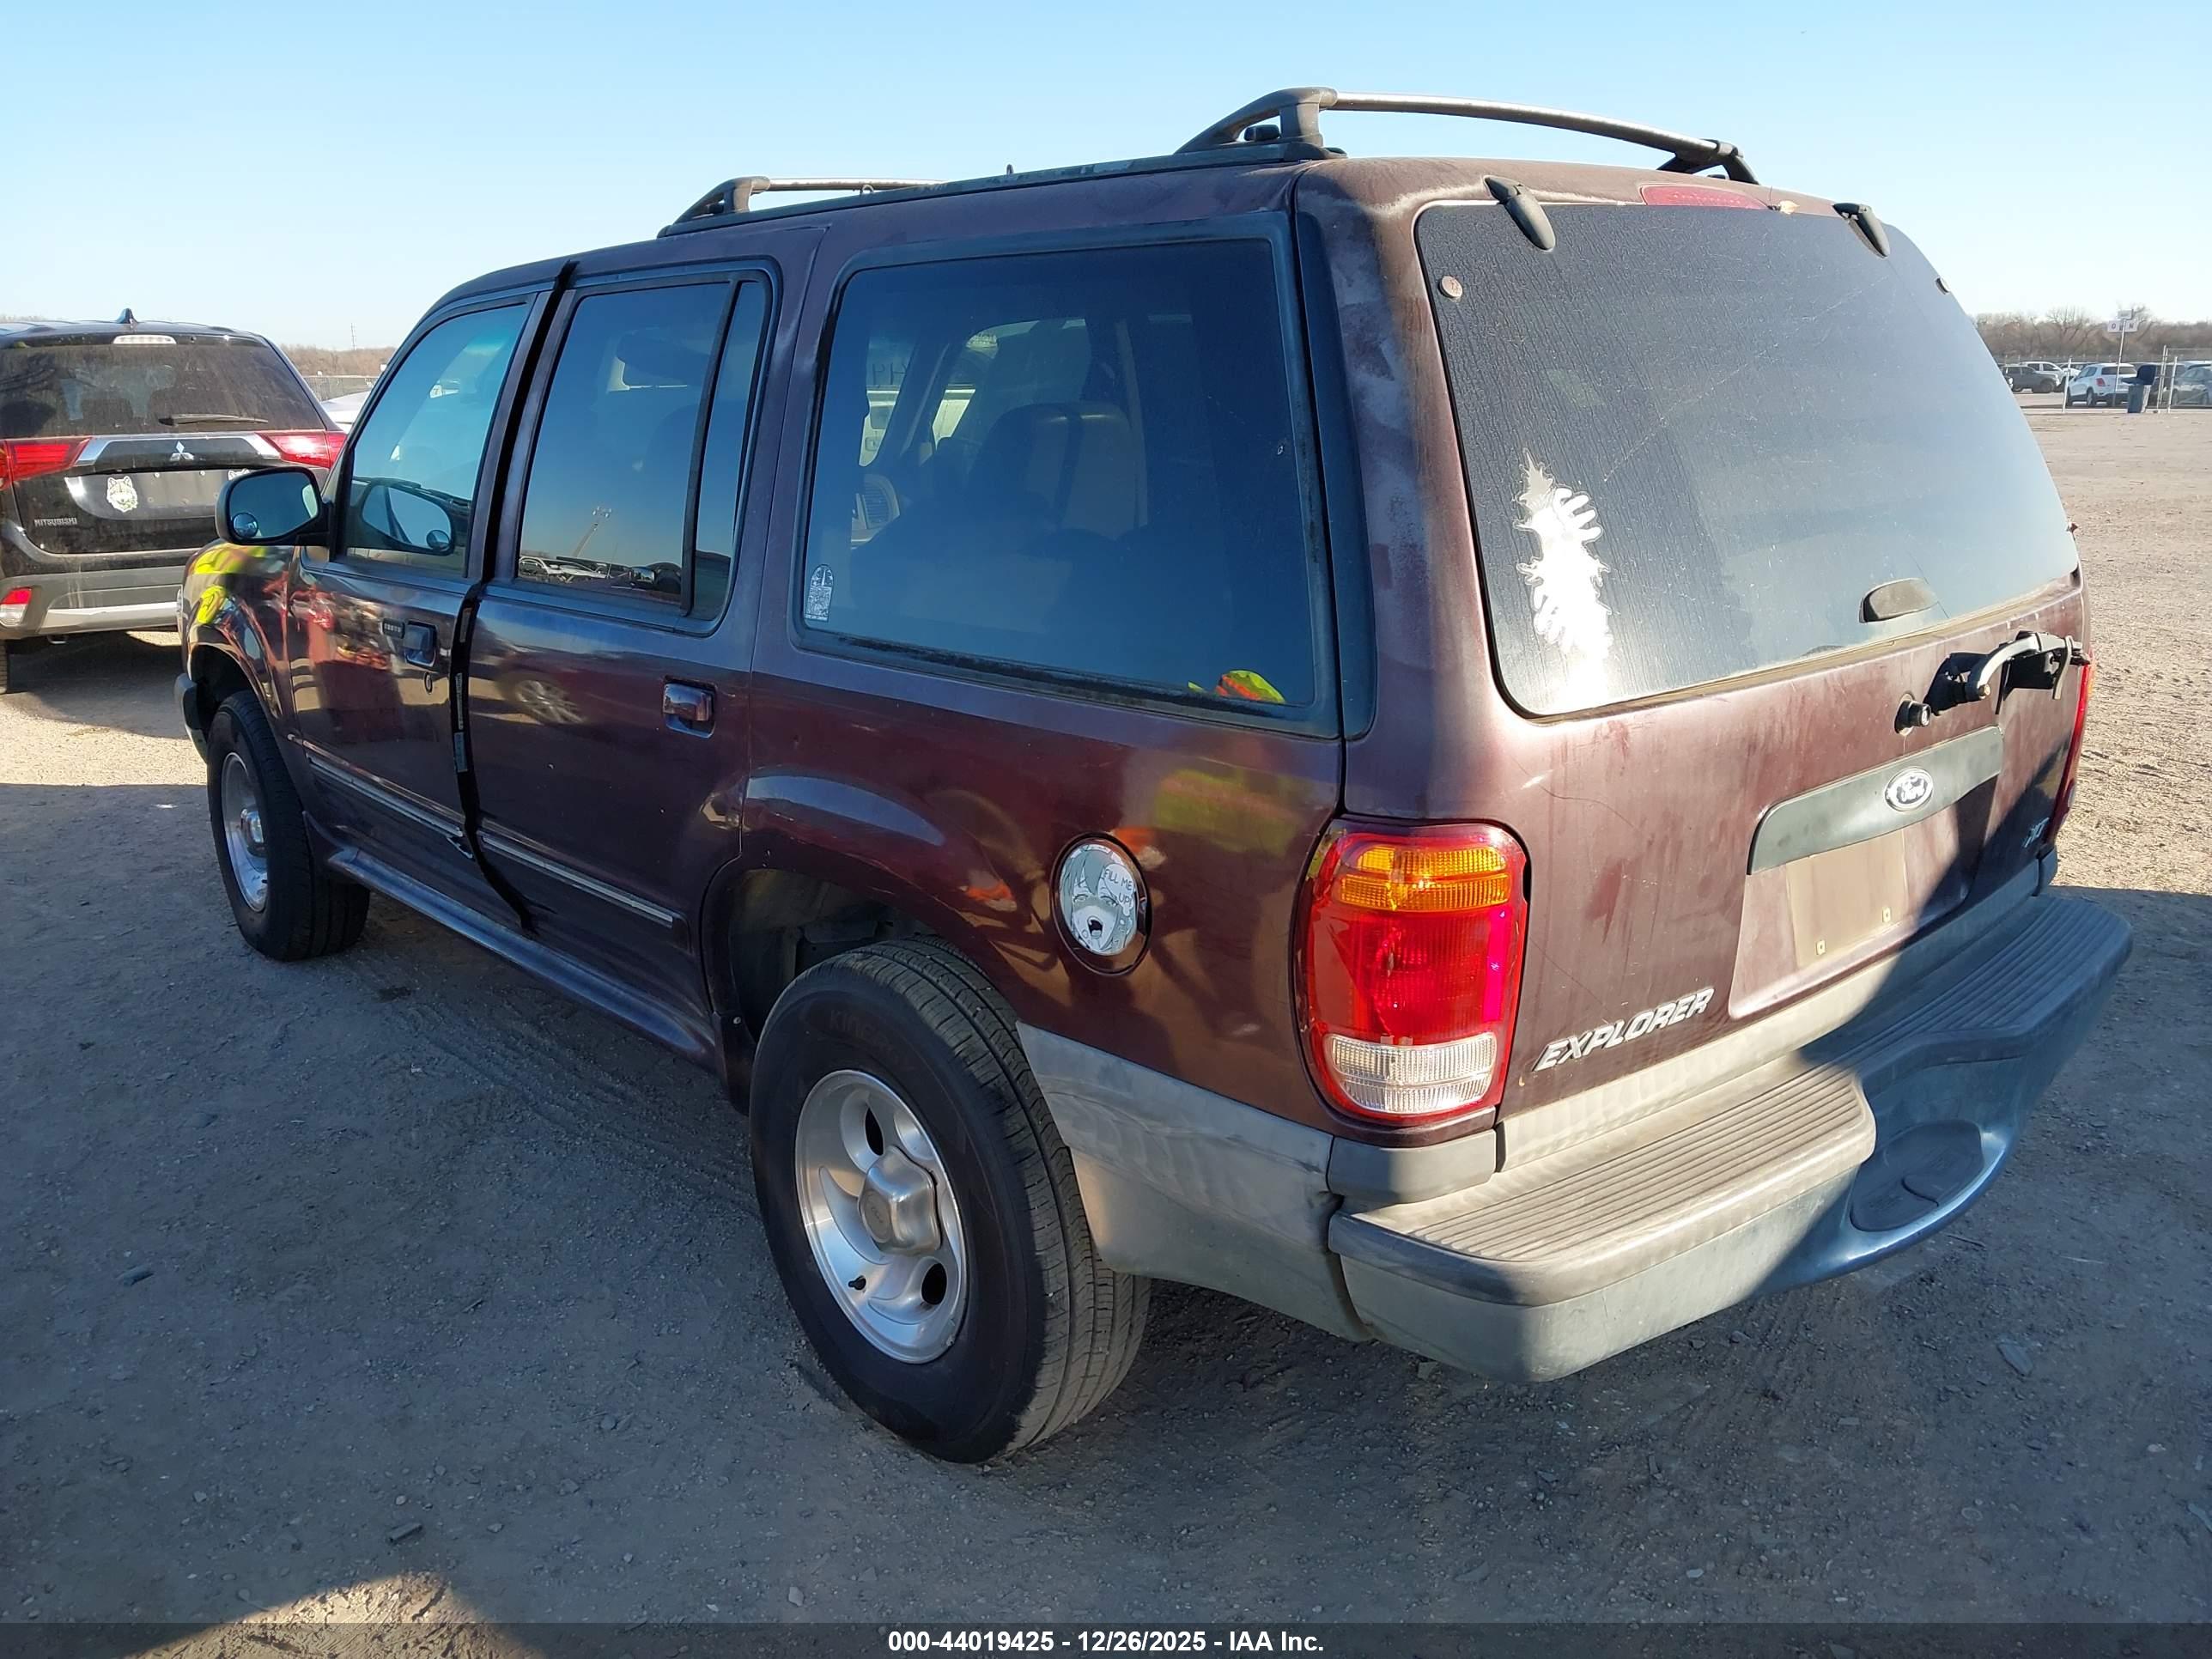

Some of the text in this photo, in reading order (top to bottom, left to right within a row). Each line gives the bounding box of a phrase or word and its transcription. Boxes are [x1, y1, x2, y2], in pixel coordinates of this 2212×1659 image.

[33, 517, 77, 527] MITSUBISHI
[1104, 868, 1133, 890] FILL ME
[1532, 987, 1716, 1072] EXPLORER
